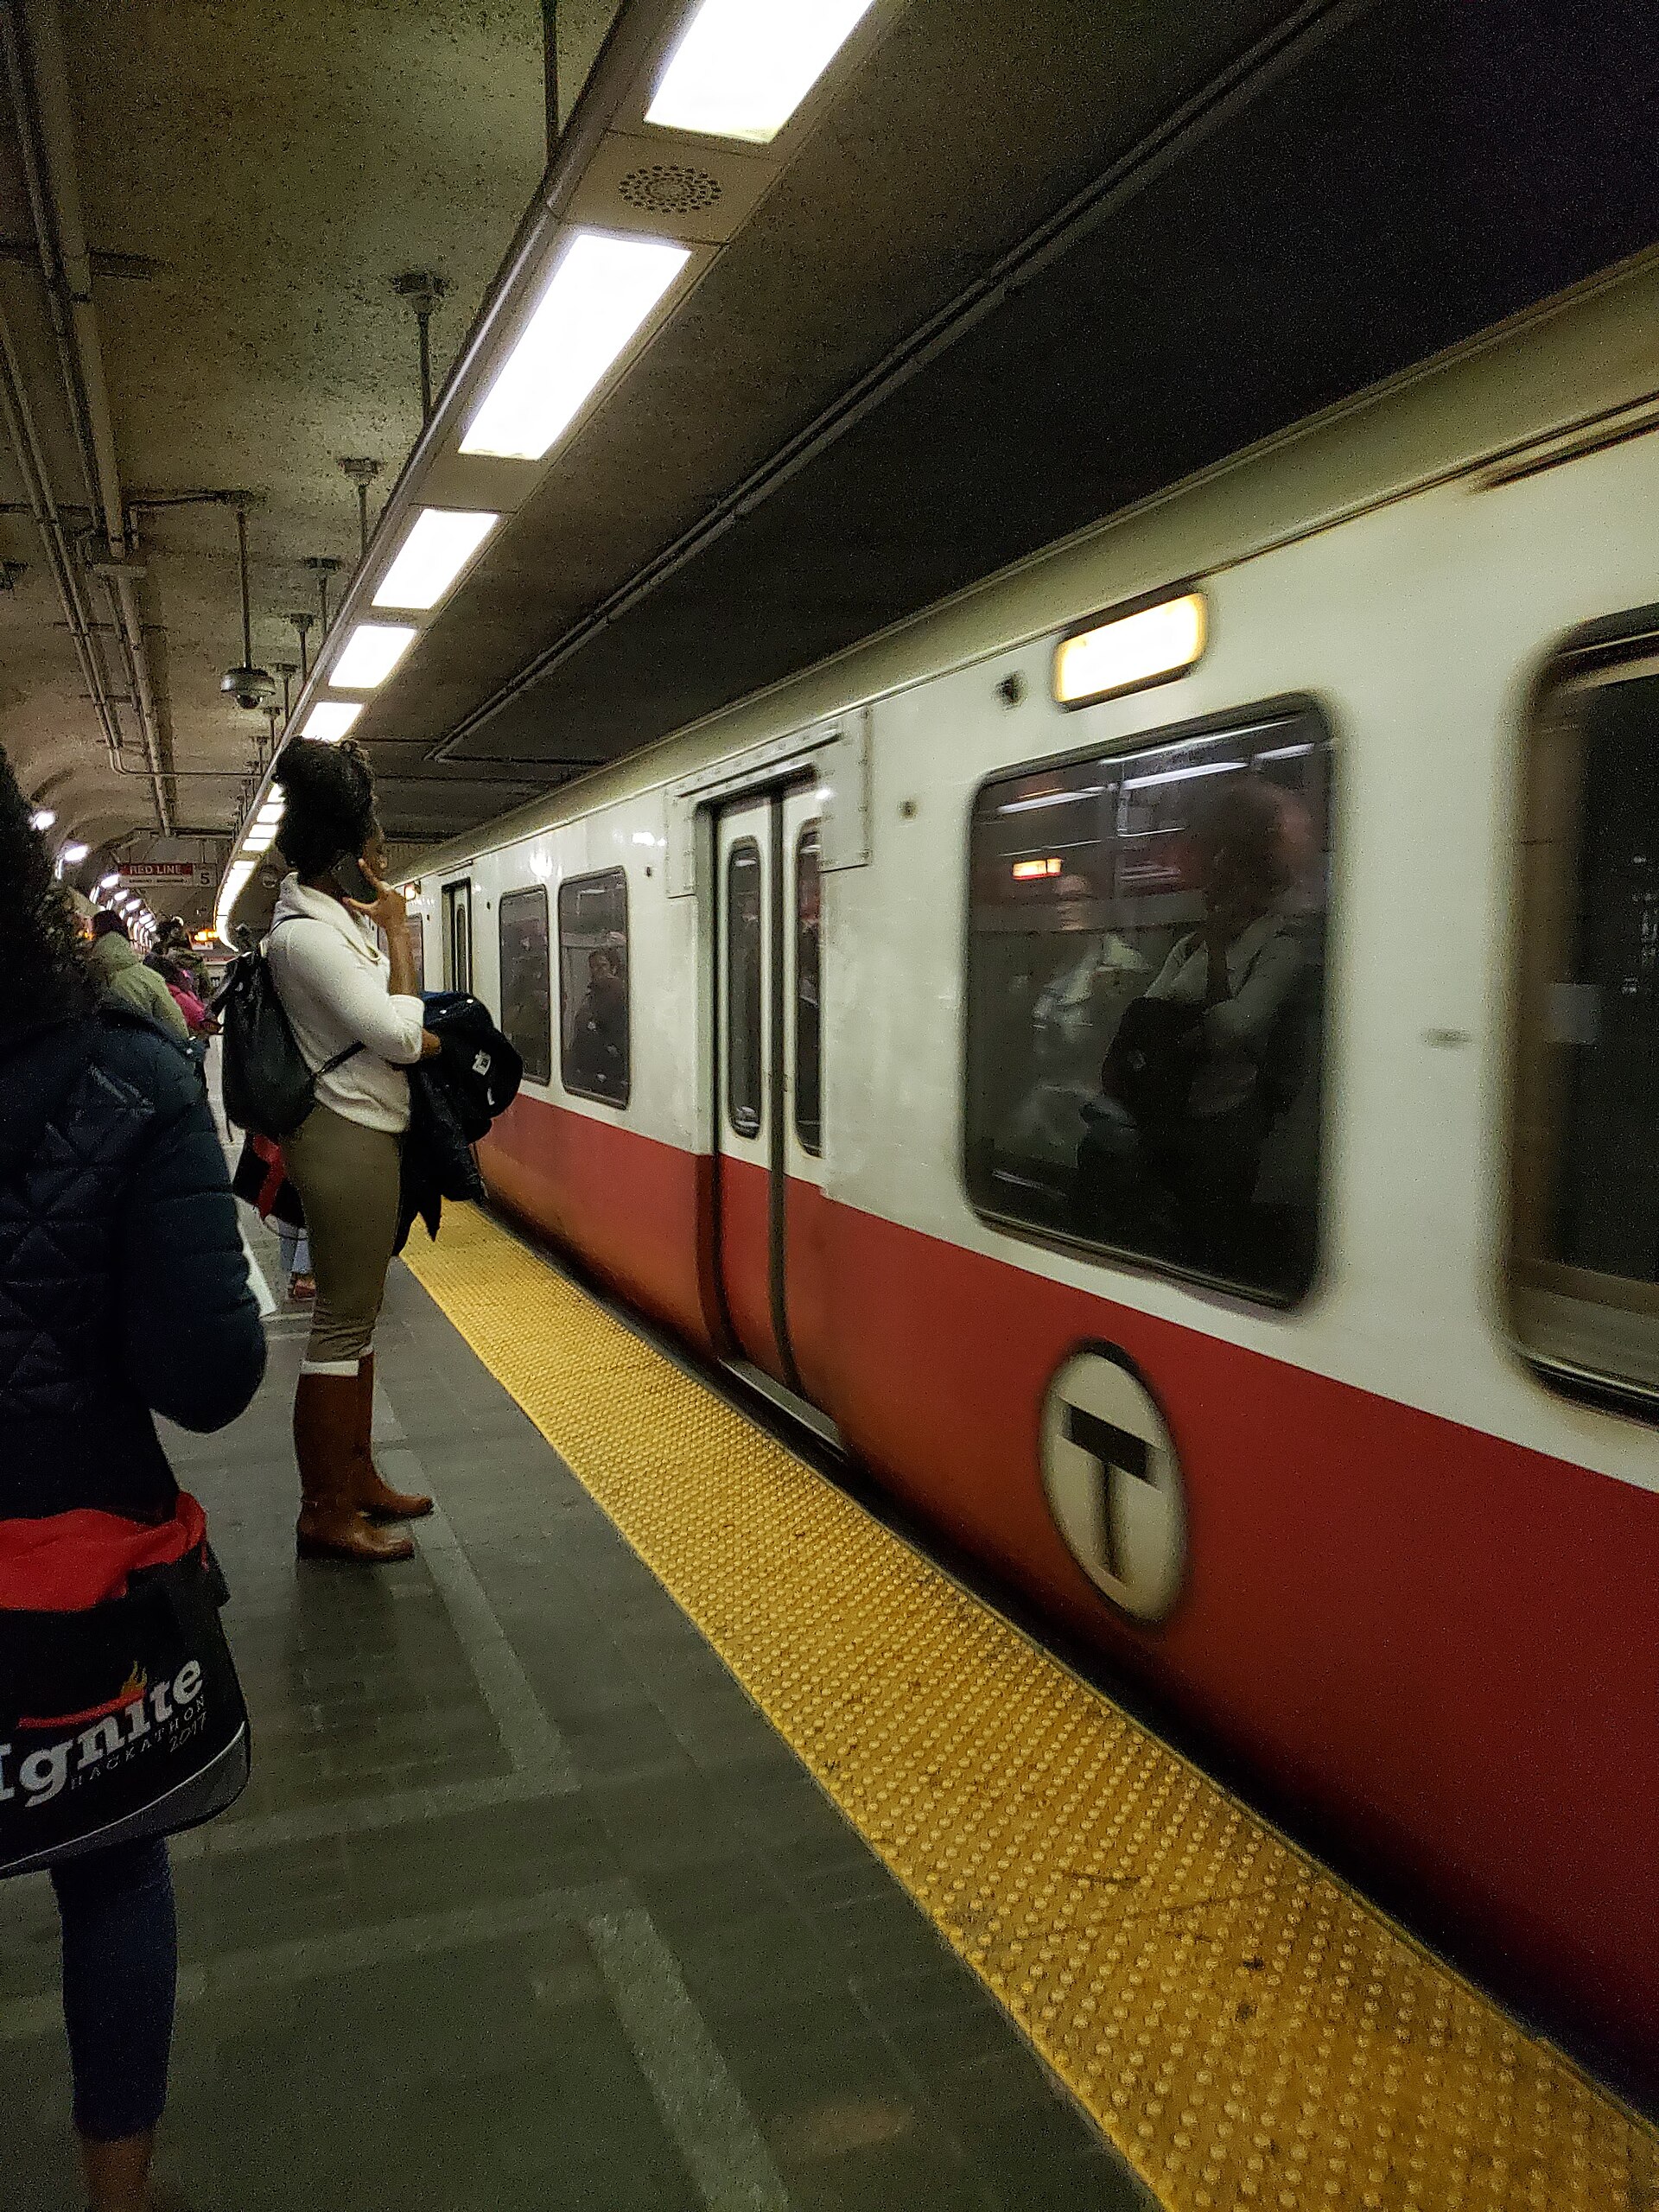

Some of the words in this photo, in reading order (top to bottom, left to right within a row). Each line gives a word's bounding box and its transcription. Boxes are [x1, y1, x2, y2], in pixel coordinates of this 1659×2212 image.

[130, 865, 153, 874] RED
[156, 865, 182, 874] LINE
[200, 871, 210, 885] 5
[1061, 1396, 1160, 1585] T
[70, 1694, 205, 1791] HACKATHON
[169, 1711, 207, 1753] 2017
